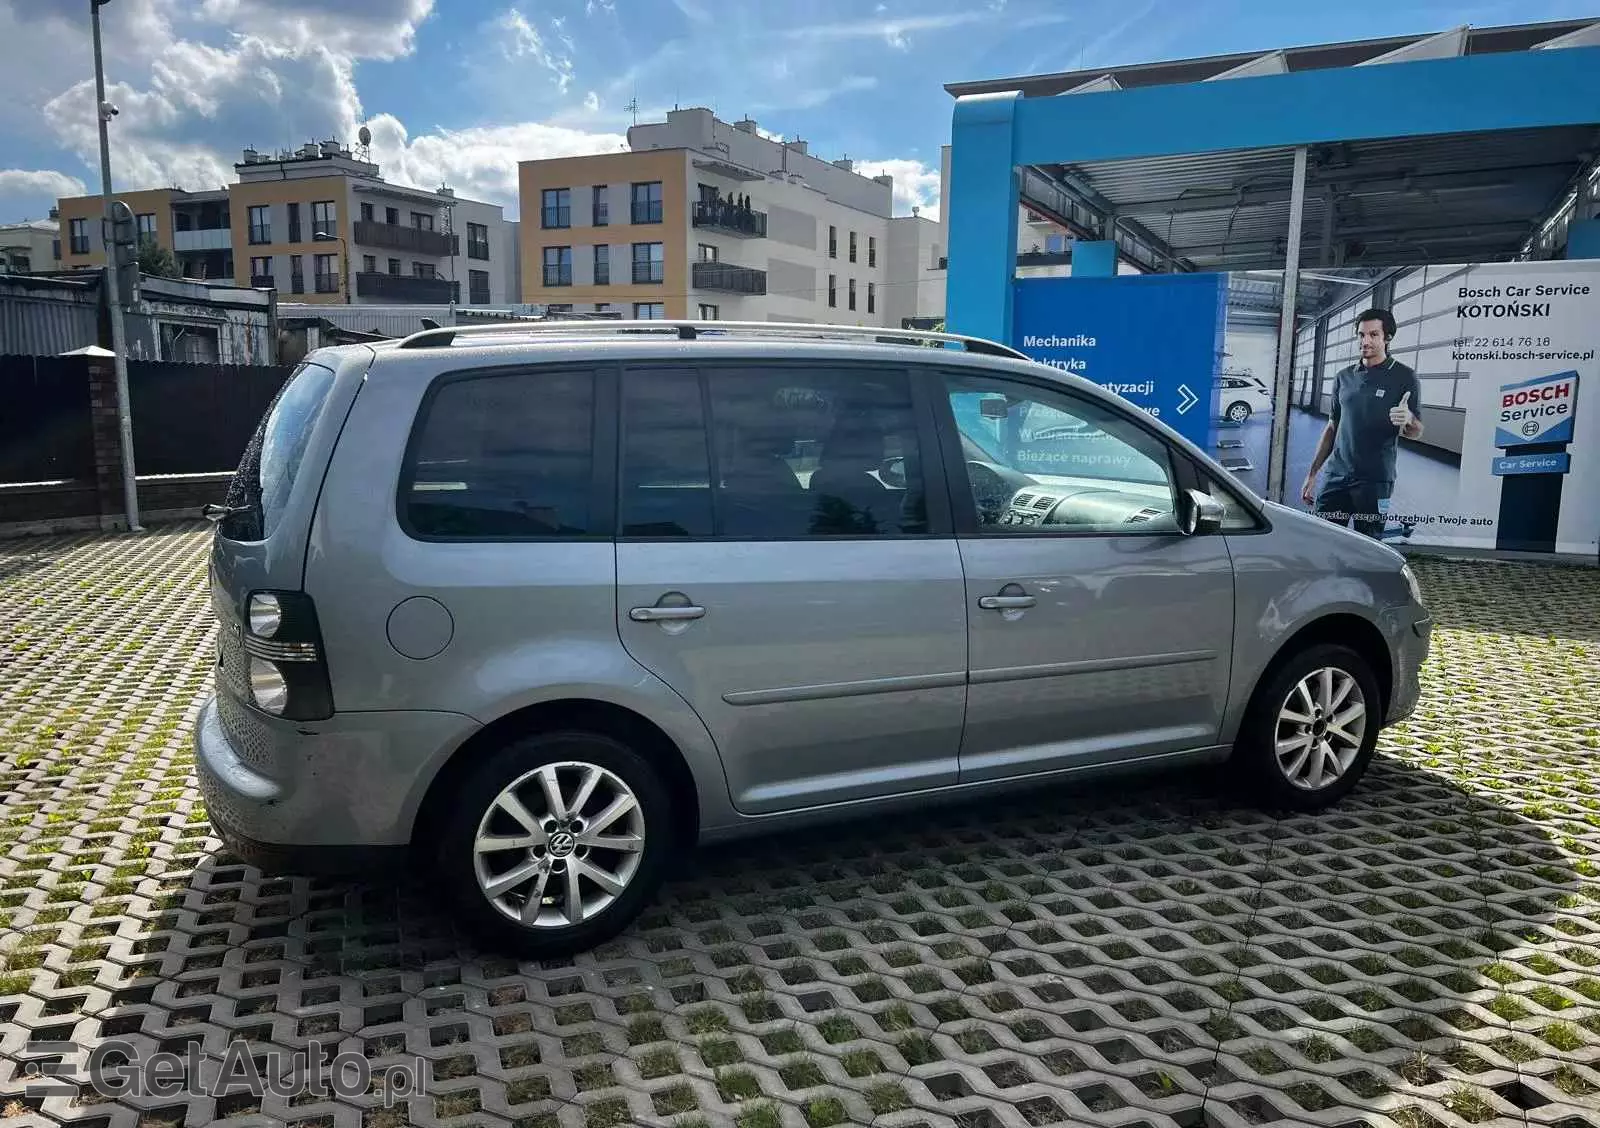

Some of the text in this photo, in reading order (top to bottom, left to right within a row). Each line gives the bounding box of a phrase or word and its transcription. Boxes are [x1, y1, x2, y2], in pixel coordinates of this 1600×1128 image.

[1458, 284, 1590, 298] Bosch Car Service
[1457, 300, 1550, 318] KOTOŃSKI
[1024, 335, 1096, 347] Mechanika
[1474, 338, 1489, 347] 22
[1492, 338, 1513, 347] 614
[1518, 338, 1532, 347] 76
[1536, 337, 1550, 346] 18
[1452, 350, 1594, 360] kotonski.bosch-service.pl
[1503, 383, 1569, 408] BOSCH
[1500, 403, 1568, 422] Service
[1499, 459, 1557, 469] Car Service
[1383, 513, 1435, 524] potrzebuje
[1439, 515, 1468, 526] Twoje
[1470, 517, 1493, 526] auto
